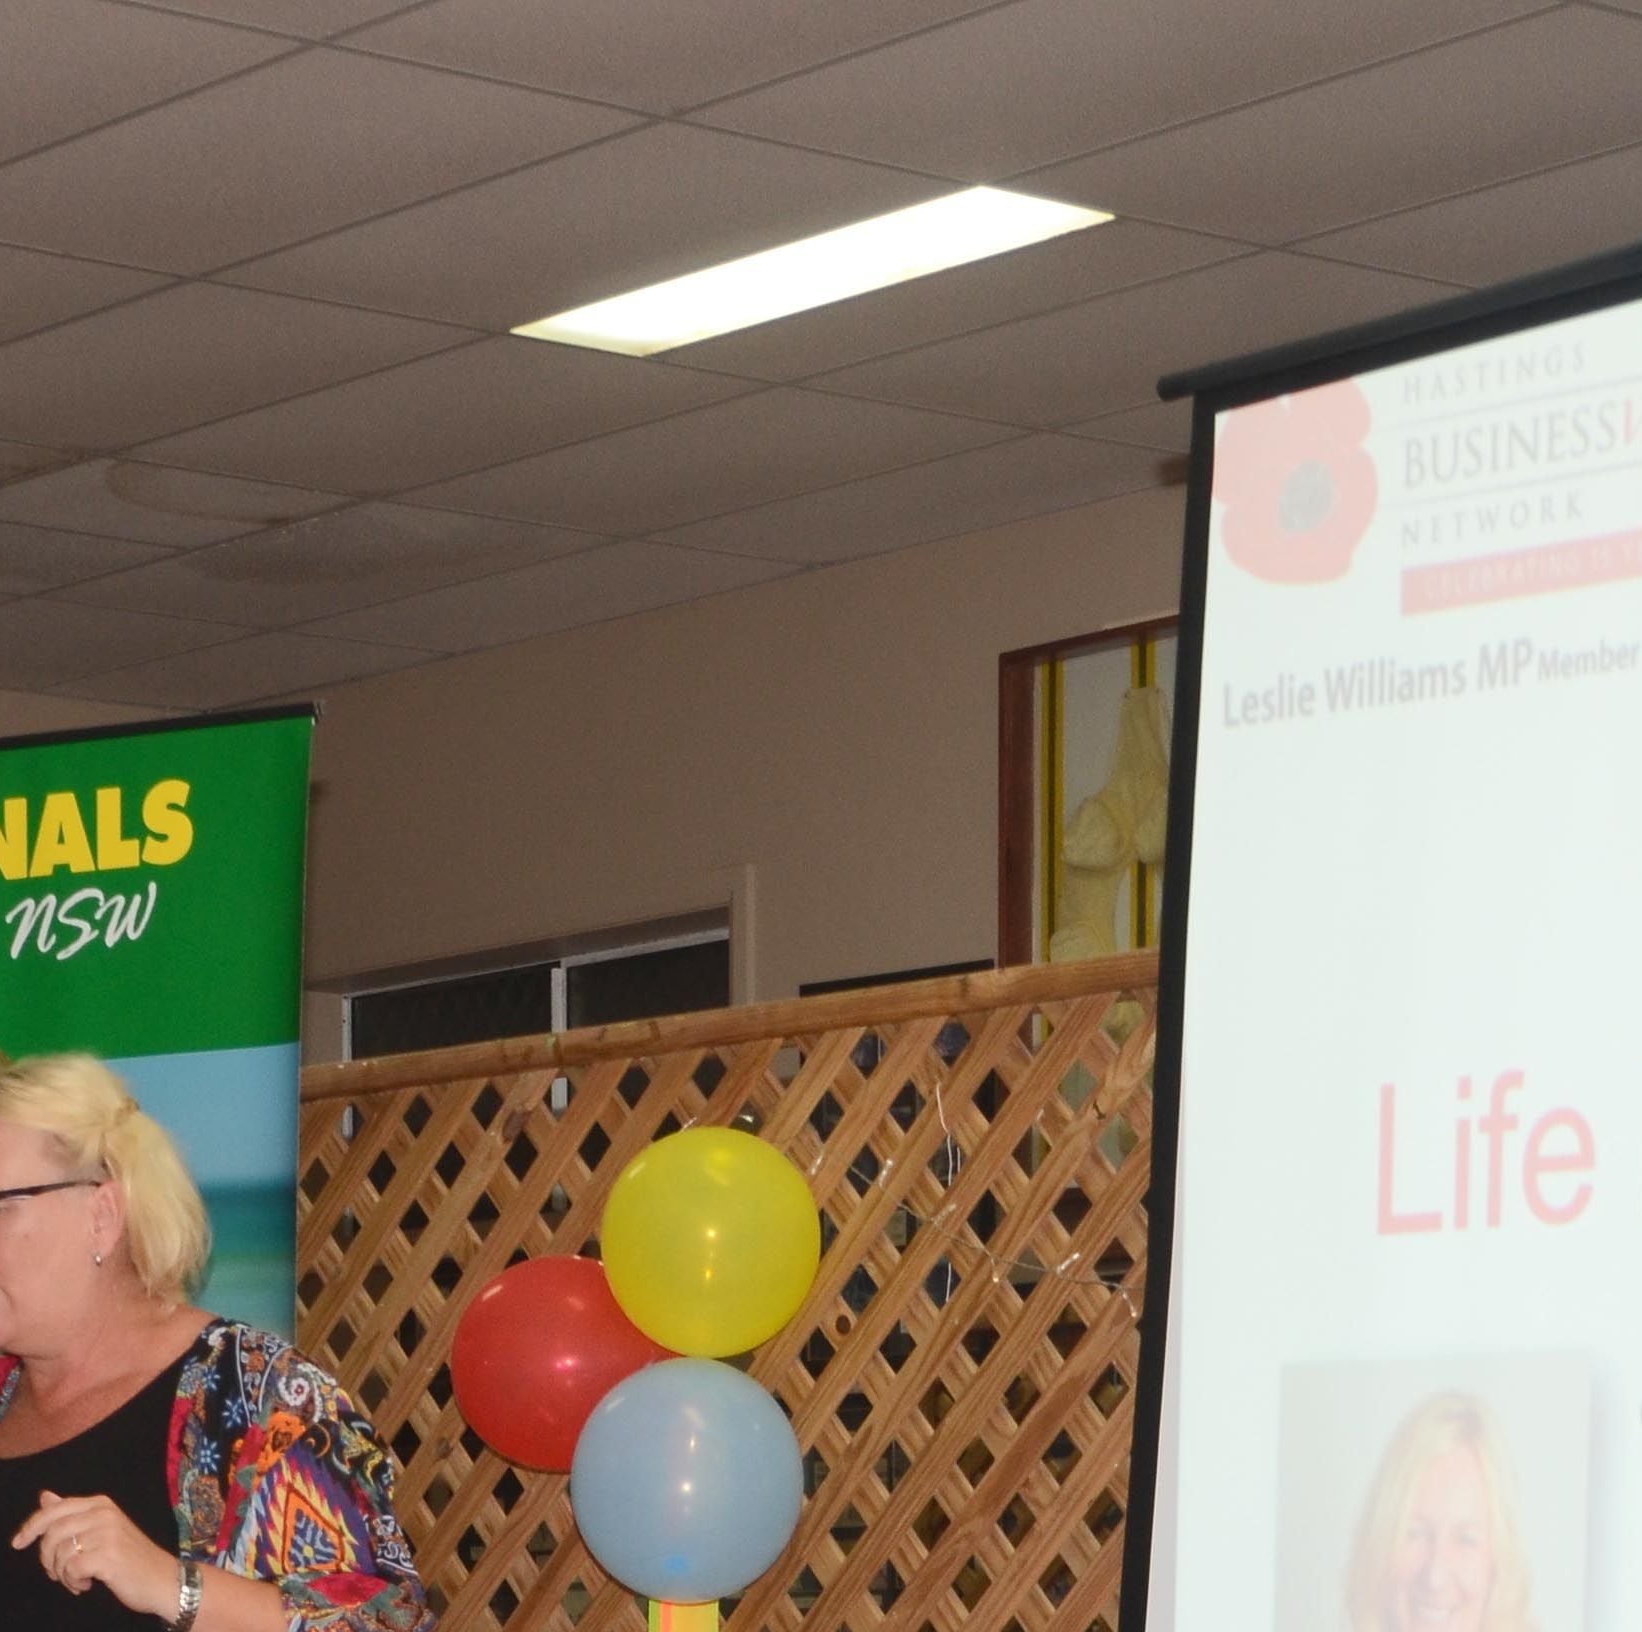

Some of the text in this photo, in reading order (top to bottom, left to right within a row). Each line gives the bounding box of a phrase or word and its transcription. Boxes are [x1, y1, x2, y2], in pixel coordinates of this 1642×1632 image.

[1402, 341, 1588, 406] HASTINGS
[1401, 493, 1585, 549] NETWORK
[1222, 674, 1316, 729] Leslie
[1324, 655, 1467, 713] Williams
[1477, 637, 1534, 692] MP
[1538, 638, 1641, 682] Member
[6, 881, 157, 960] NSW
[1375, 1070, 1598, 1237] Life
